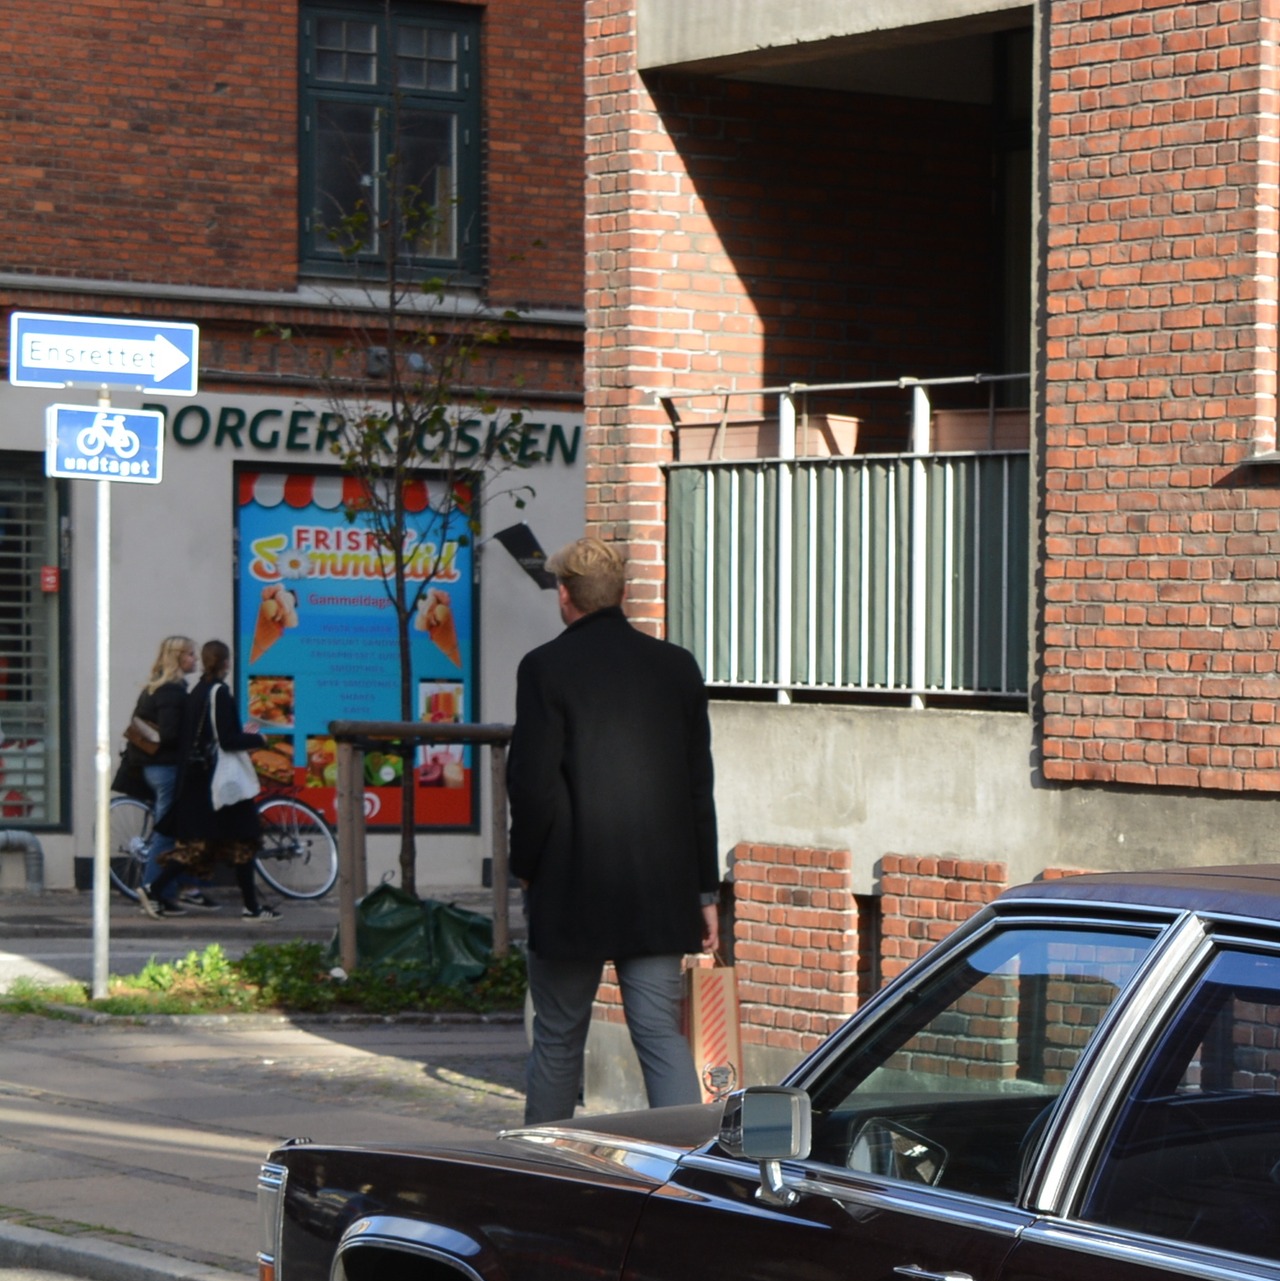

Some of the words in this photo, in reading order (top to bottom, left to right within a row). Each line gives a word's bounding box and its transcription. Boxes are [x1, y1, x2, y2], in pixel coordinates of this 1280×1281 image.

[30, 340, 156, 368] Ensrettet
[362, 414, 582, 465] KOSKEN
[64, 456, 150, 477] undtaget
